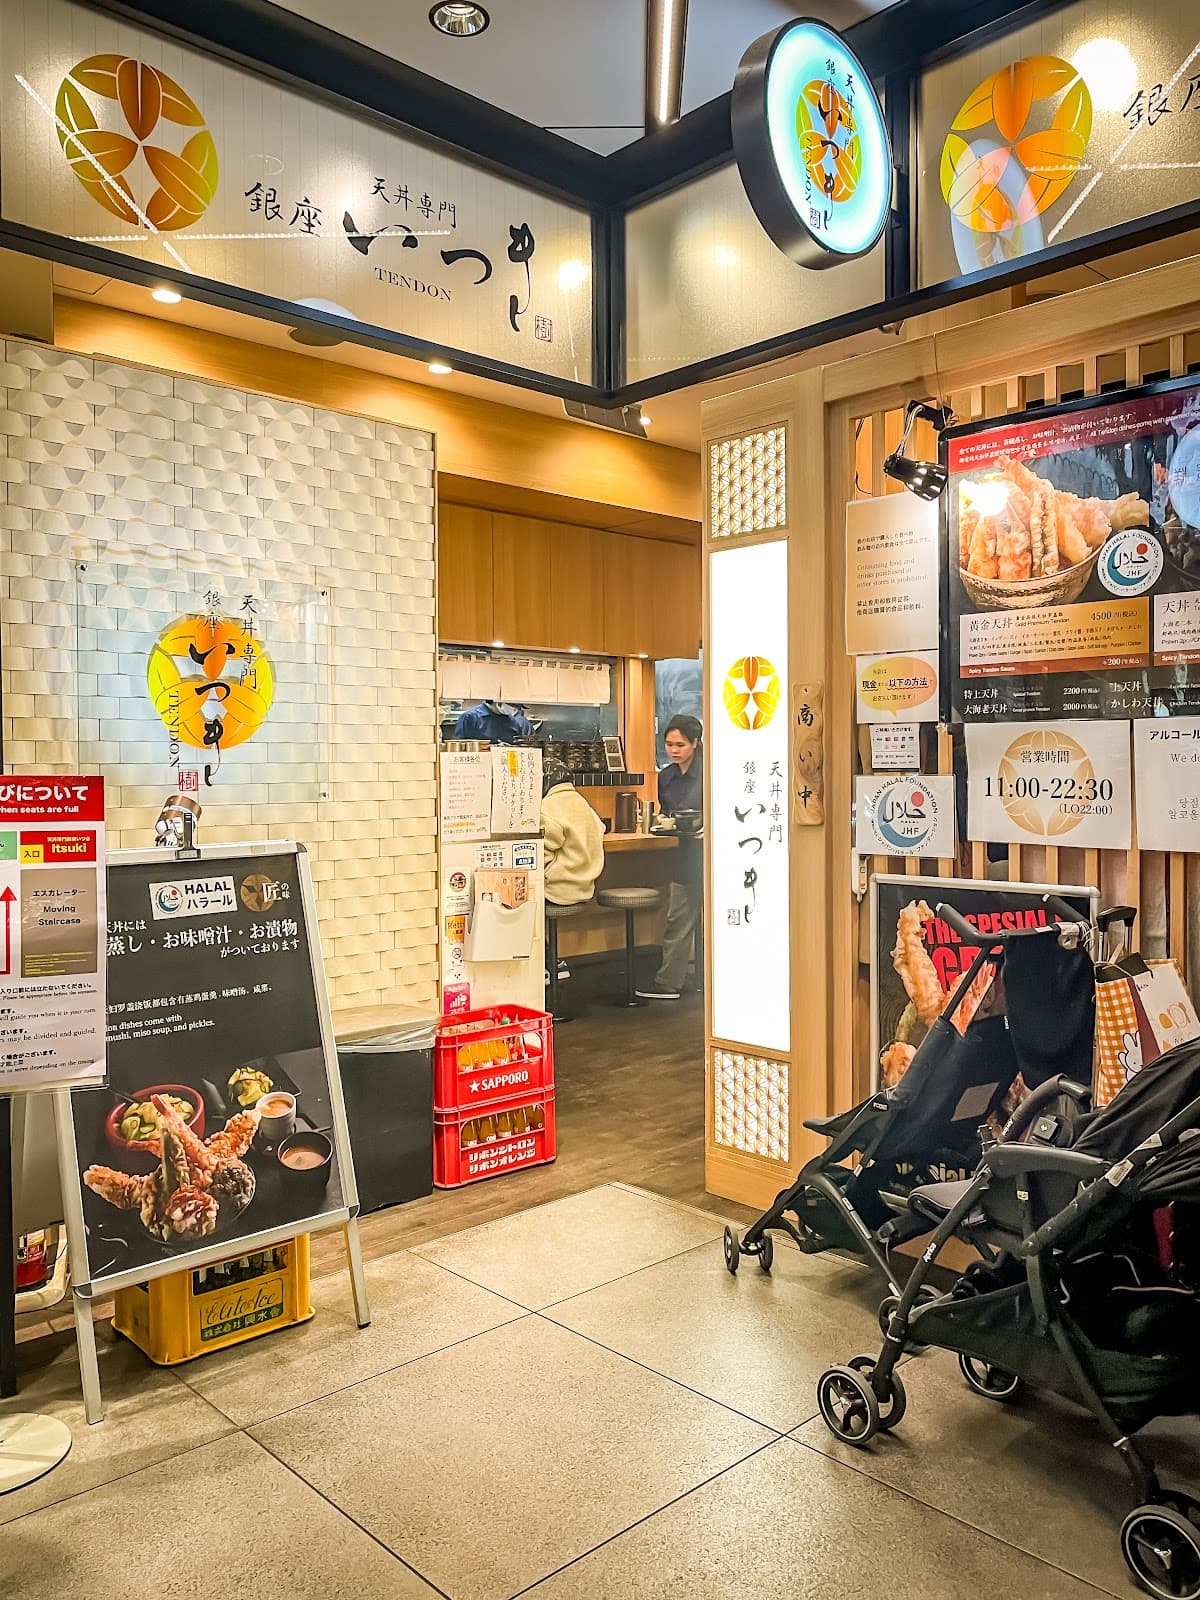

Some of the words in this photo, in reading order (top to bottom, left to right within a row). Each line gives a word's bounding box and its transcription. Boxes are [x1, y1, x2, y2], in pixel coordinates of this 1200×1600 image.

[245, 182, 322, 237] 銀座
[369, 176, 456, 229] 天丼専門
[374, 266, 453, 301] TENDON
[202, 589, 222, 630] 銀座
[1162, 600, 1190, 614] 天丼
[964, 688, 999, 700] 特上天丼
[963, 704, 1008, 715] 大海老天丼
[168, 690, 180, 768] TENDON
[797, 703, 814, 809] 商い中
[1021, 750, 1070, 764] 営業時間
[1170, 753, 1187, 763] We
[743, 761, 756, 794] 銀座
[882, 777, 904, 790] HALAL
[905, 777, 938, 813] FOUNDATION
[984, 776, 1113, 801] 11:00-22:30
[0, 805, 18, 814] hen
[20, 806, 45, 814] seats
[64, 805, 79, 813] full
[883, 800, 926, 823] حلال
[1059, 803, 1113, 816] (LO22:00)
[24, 850, 40, 858] 入口
[52, 842, 87, 854] Itsuki
[33, 888, 88, 897] エスカレーター
[184, 881, 232, 895] HALAL
[43, 905, 76, 914] Moving
[187, 895, 233, 910] ハラール
[38, 918, 81, 926] Staircase
[220, 938, 300, 958] がついております
[10, 1014, 26, 1022] guide
[119, 1019, 143, 1031] dishes
[144, 1018, 165, 1027] come
[166, 1013, 183, 1024] with
[33, 1032, 58, 1040] divided
[74, 1027, 96, 1036] guided.
[133, 1029, 152, 1039] miso
[173, 1022, 187, 1032] and
[188, 1019, 216, 1031] pickles.
[30, 1062, 58, 1071] depending
[481, 1070, 529, 1091] SAPPORO
